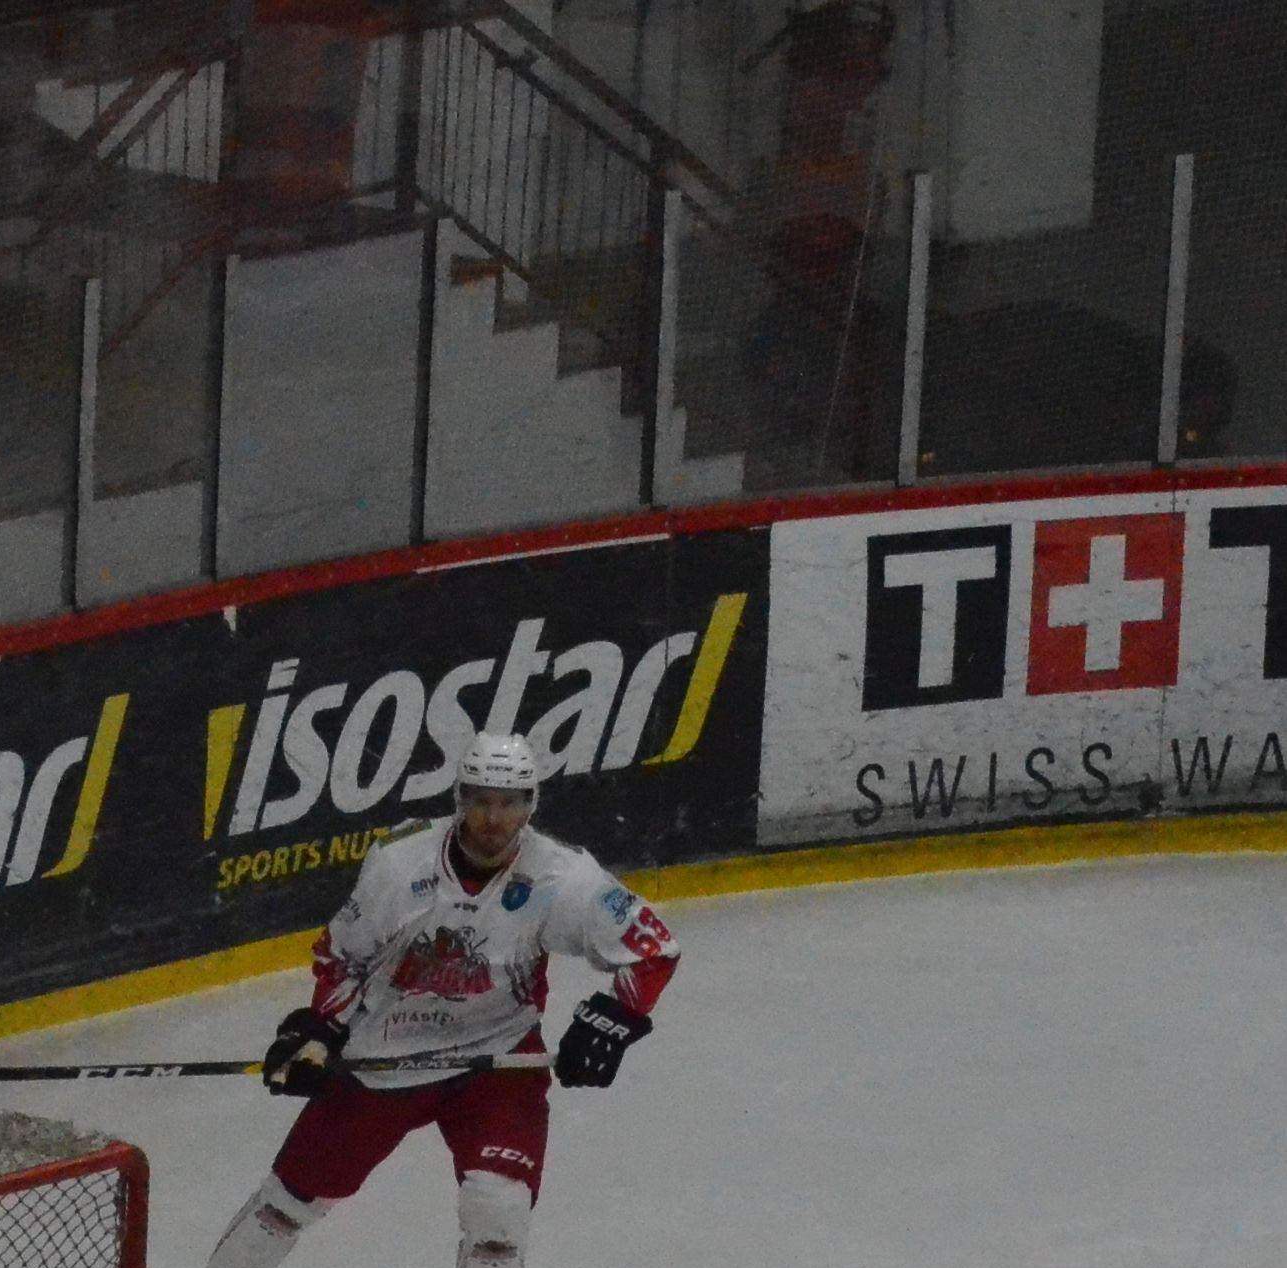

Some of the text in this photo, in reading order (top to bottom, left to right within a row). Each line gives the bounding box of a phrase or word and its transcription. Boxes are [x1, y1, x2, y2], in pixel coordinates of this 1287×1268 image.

[228, 617, 698, 837] isostar
[851, 742, 1114, 829] SWISS
[217, 839, 323, 889] SPORTS
[77, 1064, 184, 1081] CCM
